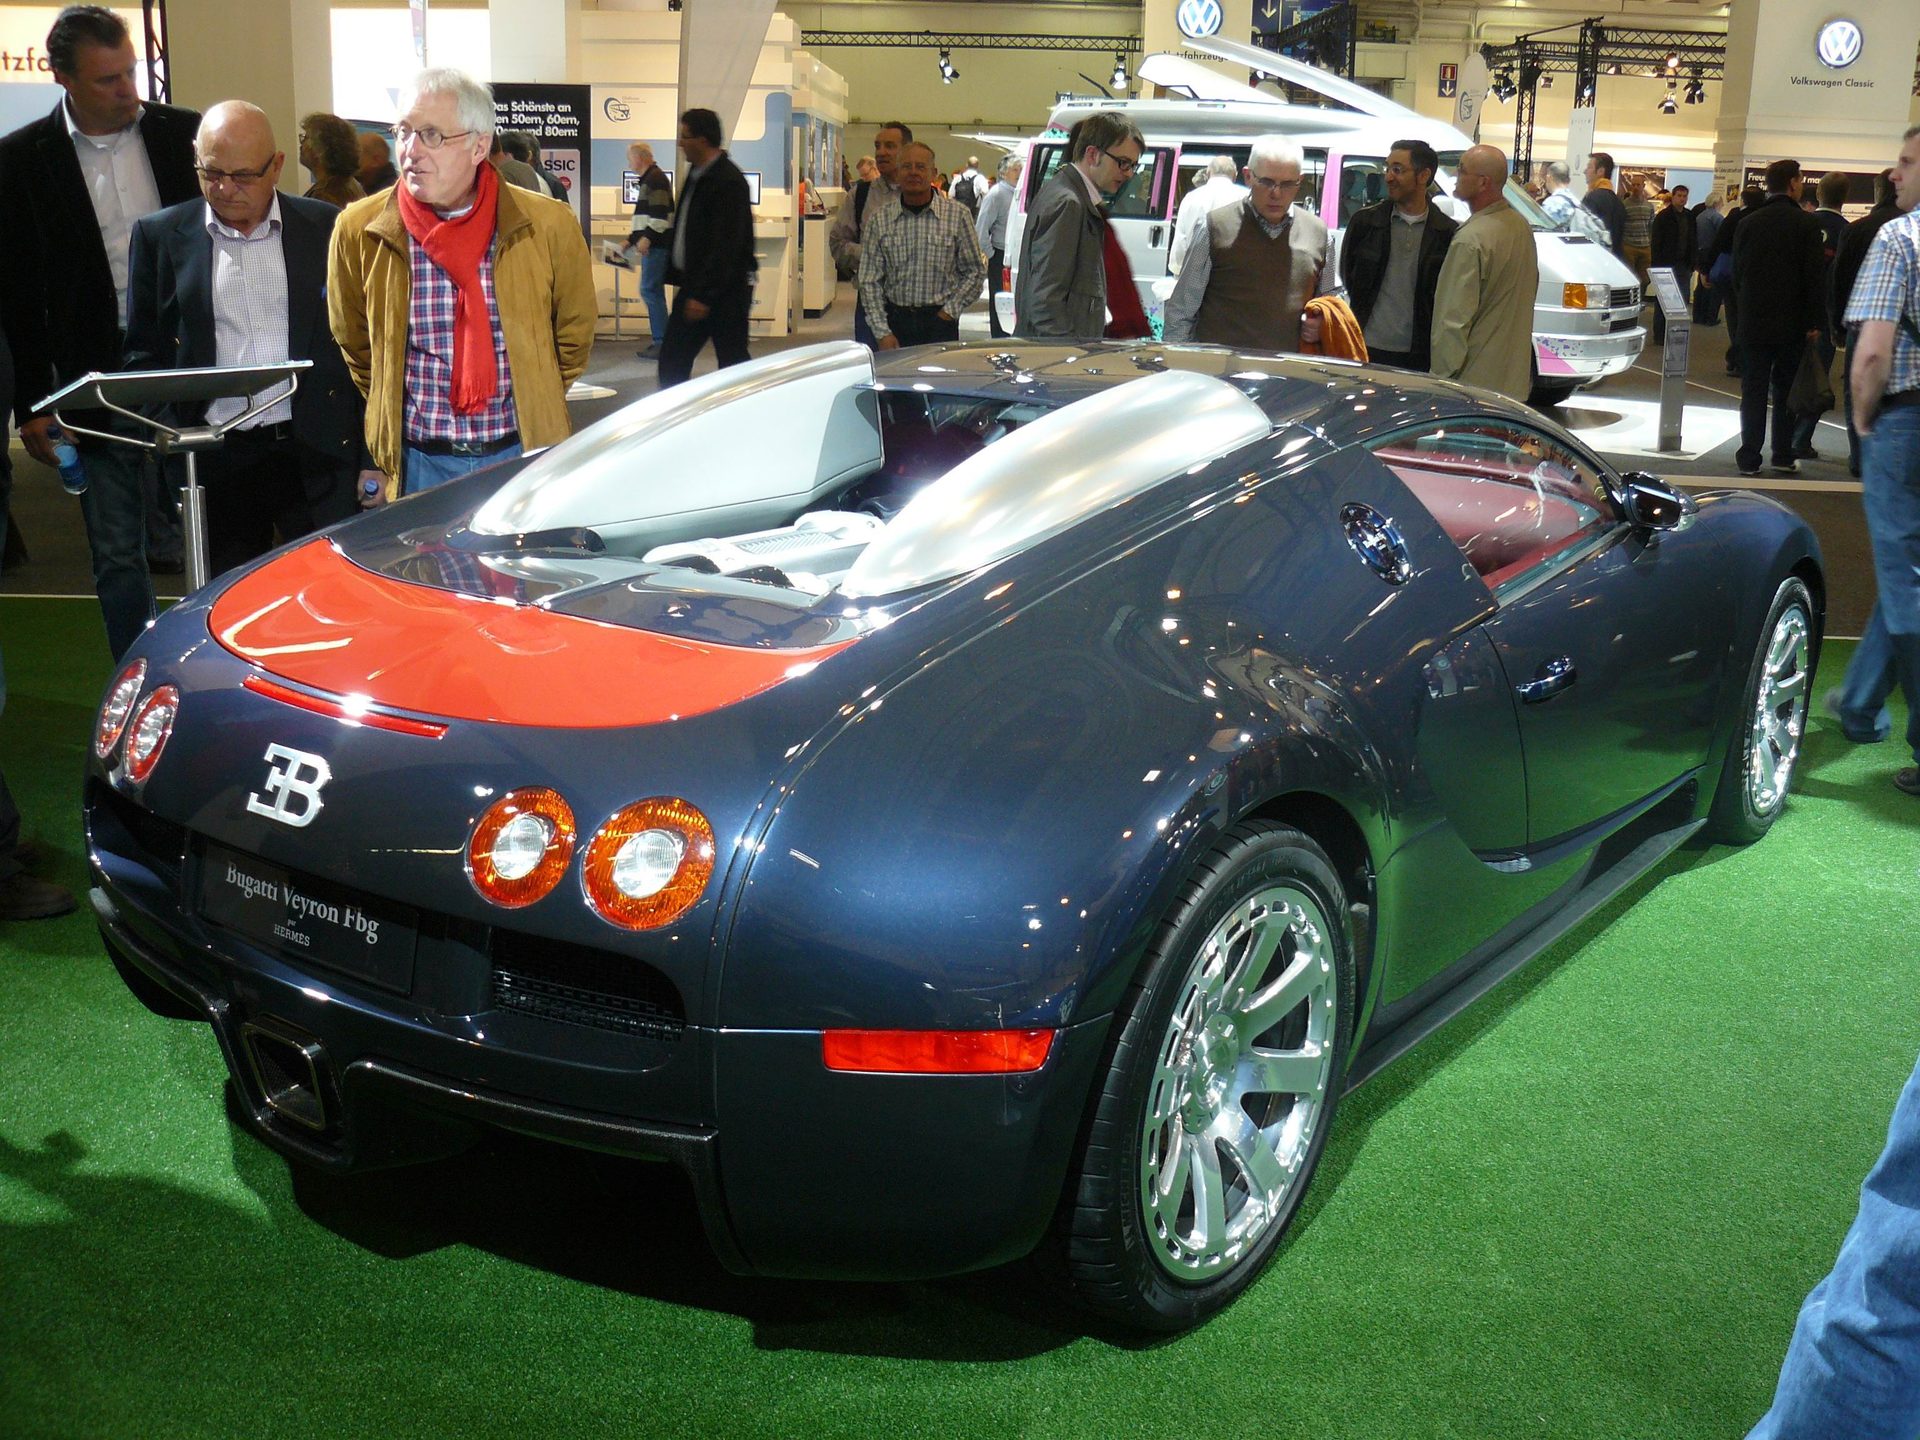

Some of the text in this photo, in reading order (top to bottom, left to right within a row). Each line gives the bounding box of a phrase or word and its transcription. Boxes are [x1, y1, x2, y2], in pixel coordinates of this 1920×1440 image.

[1790, 76, 1875, 88] Volkswagen Classic
[511, 101, 555, 112] Schönste
[557, 104, 571, 112] an
[495, 113, 509, 124] en
[546, 114, 580, 126] 60em,
[545, 126, 578, 137] 80em:
[225, 861, 380, 945] Bugatti Veyron Fbg
